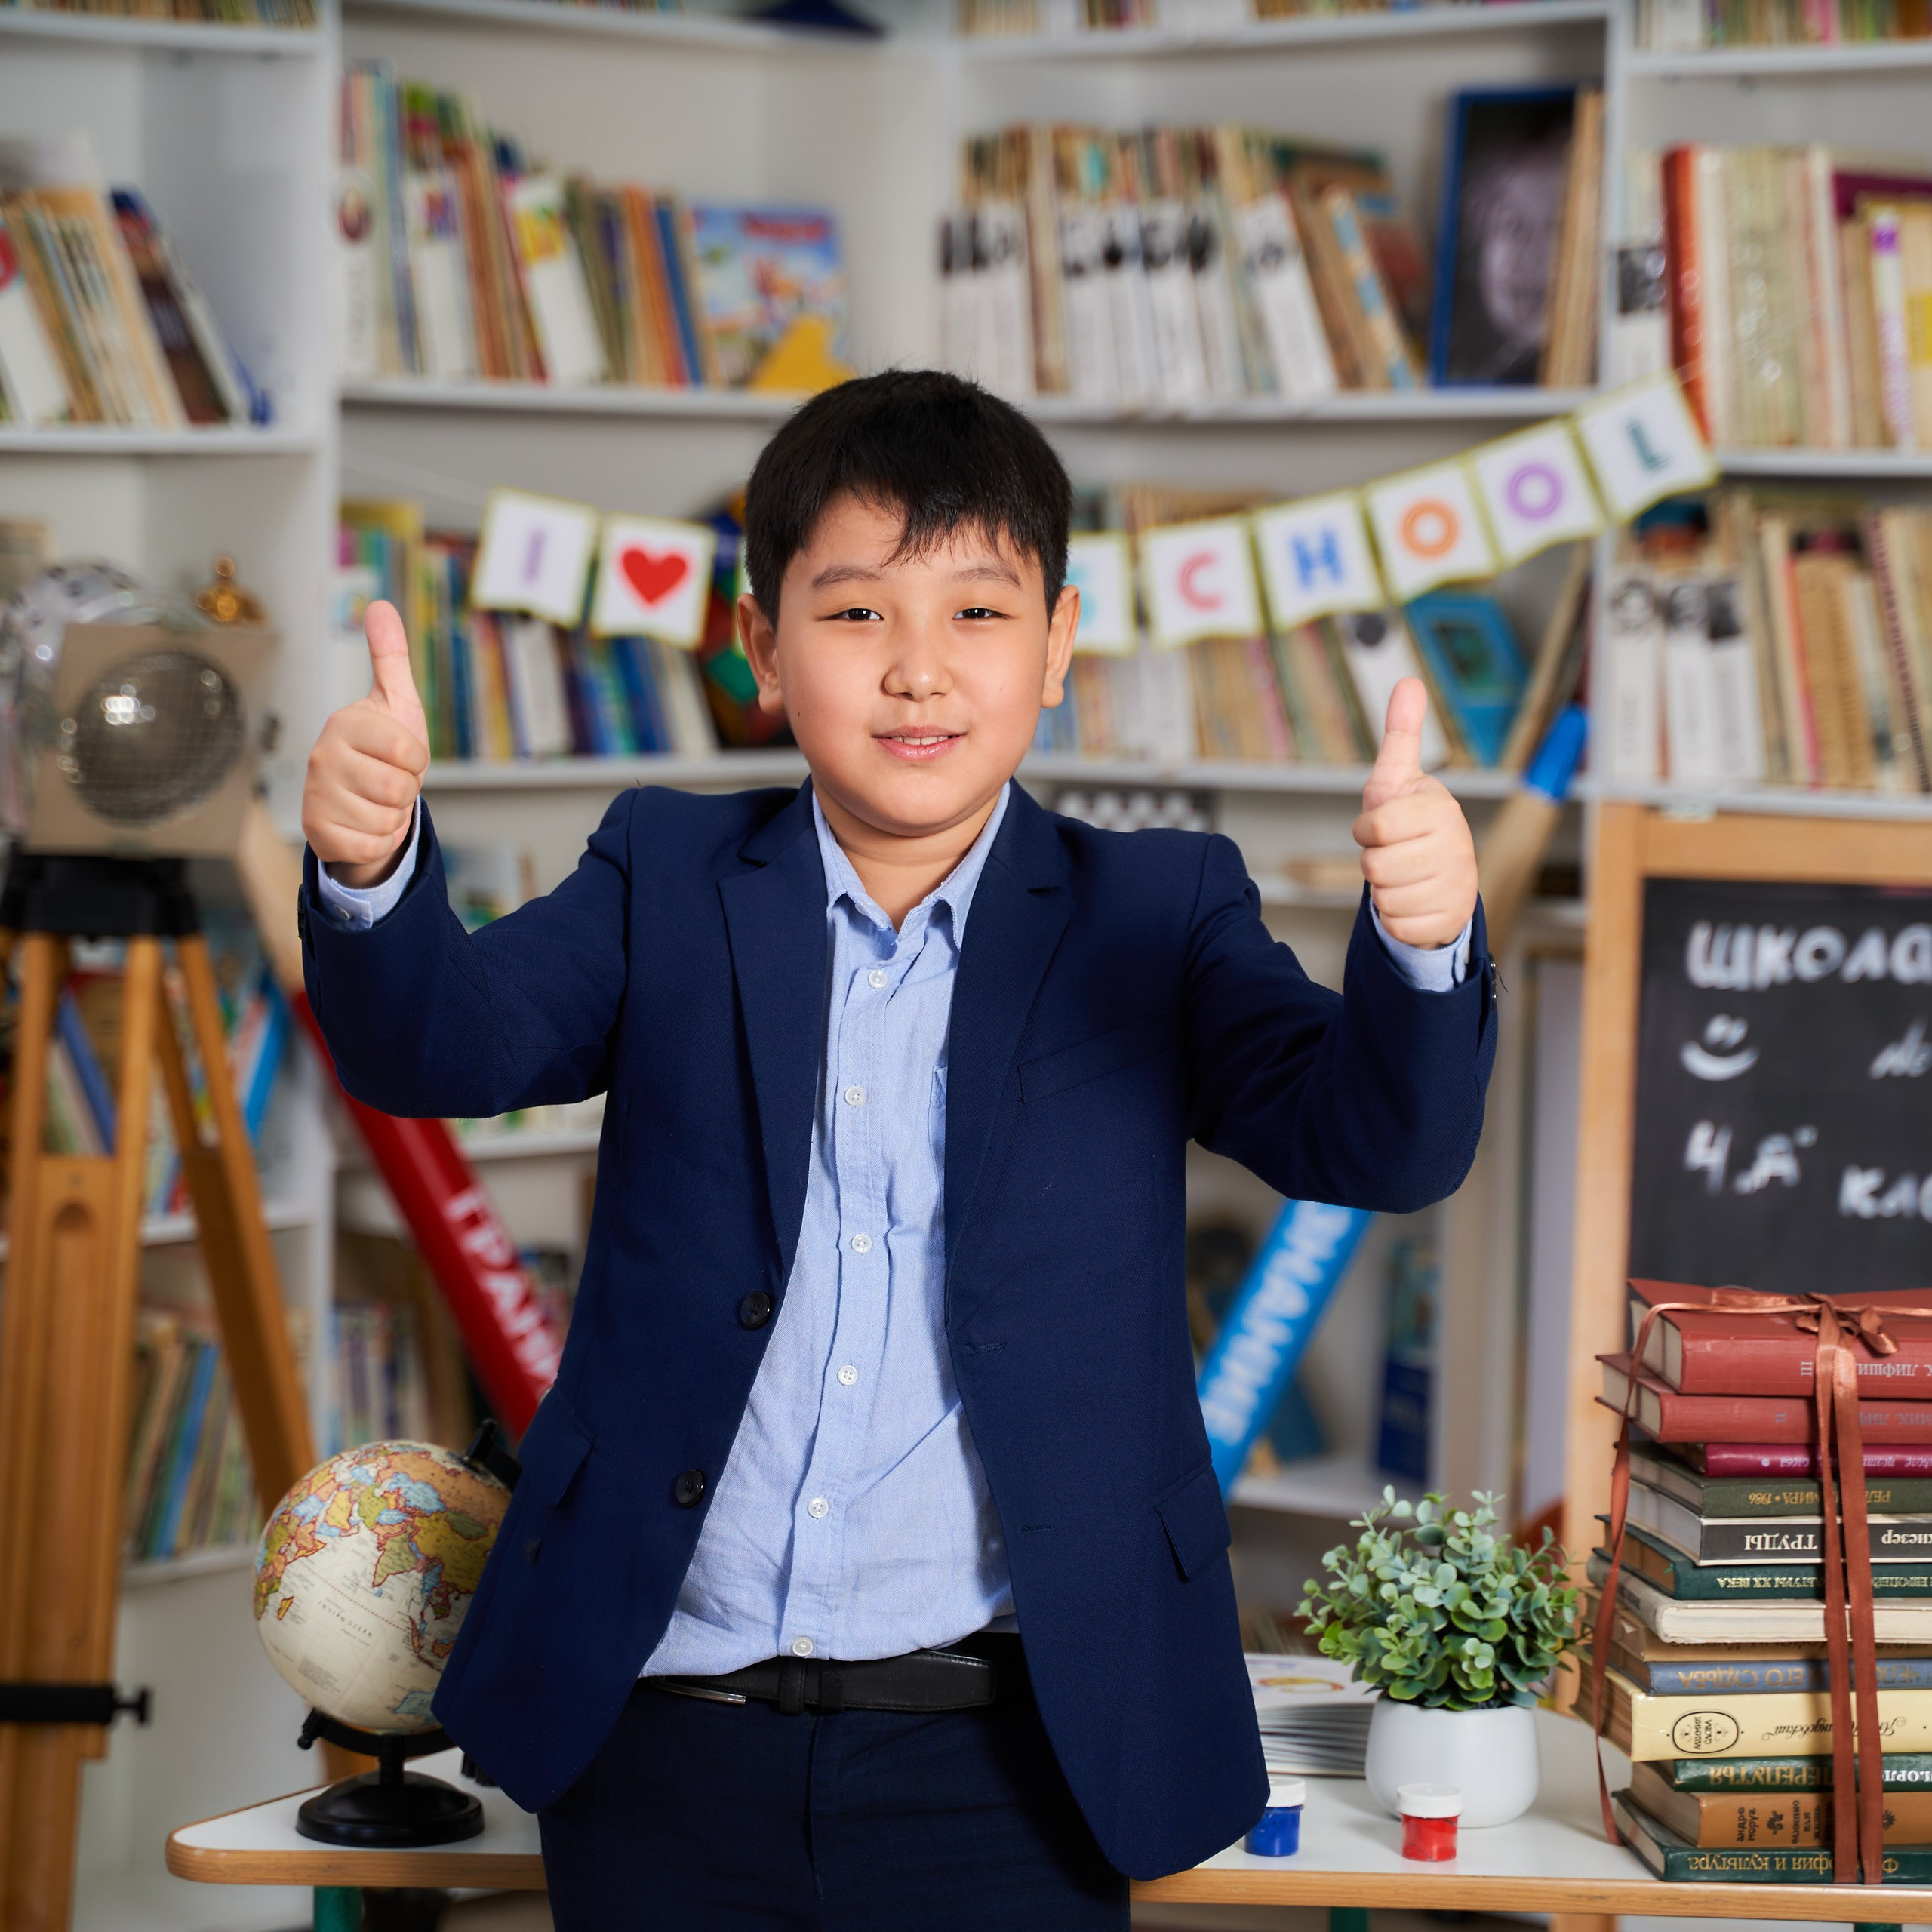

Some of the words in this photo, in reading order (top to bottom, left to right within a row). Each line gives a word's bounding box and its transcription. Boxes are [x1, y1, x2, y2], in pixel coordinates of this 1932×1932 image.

[1856, 1362, 1918, 1377] ЛИФШИ
[1748, 1491, 1773, 1505] 1986
[1744, 1532, 1818, 1551] ТРУДЫ
[1678, 1667, 1758, 1689] СУДЬБА
[1765, 1666, 1804, 1687] ЕГО
[1709, 1765, 1834, 1786] ПЕРЕПУТЬЯ
[1687, 1853, 1770, 1871] культура
